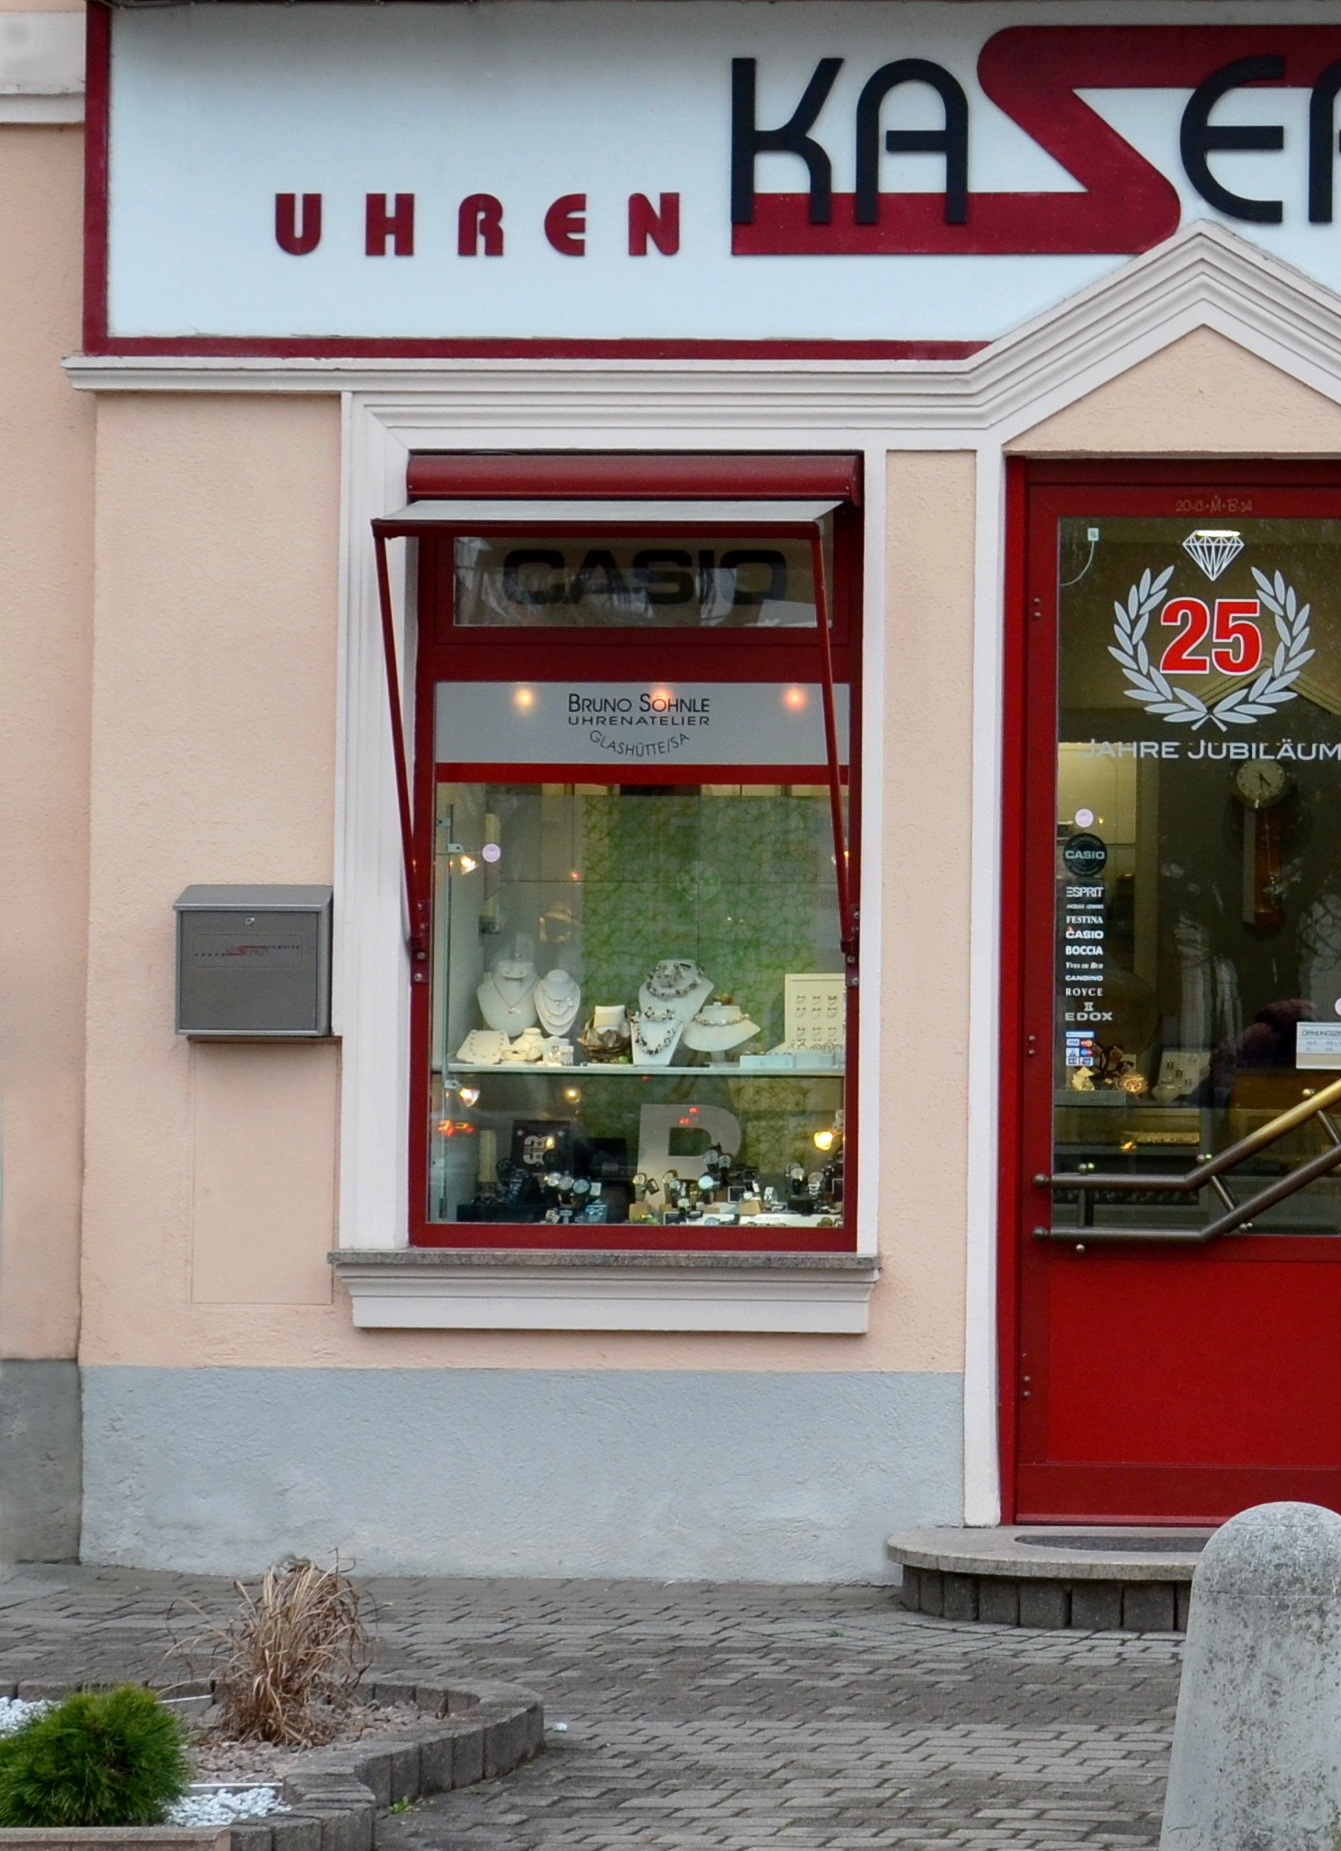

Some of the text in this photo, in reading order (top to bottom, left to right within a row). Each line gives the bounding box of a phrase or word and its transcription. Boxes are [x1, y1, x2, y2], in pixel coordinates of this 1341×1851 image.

[274, 192, 681, 257] UHREN
[504, 549, 788, 606] CASIO
[1160, 596, 1263, 676] 25
[568, 693, 633, 713] BRUNO
[568, 716, 710, 726] UHRENATELIER
[1078, 738, 1181, 760] JAHRE
[1065, 850, 1105, 860] CASIO
[1066, 886, 1104, 897] ESPRIT
[1066, 915, 1104, 924] FESTINA
[1065, 930, 1104, 939] CASIO
[1065, 946, 1104, 955] BOCCIA
[1065, 987, 1103, 997] ROYCE
[1065, 1012, 1113, 1021] EDOX
